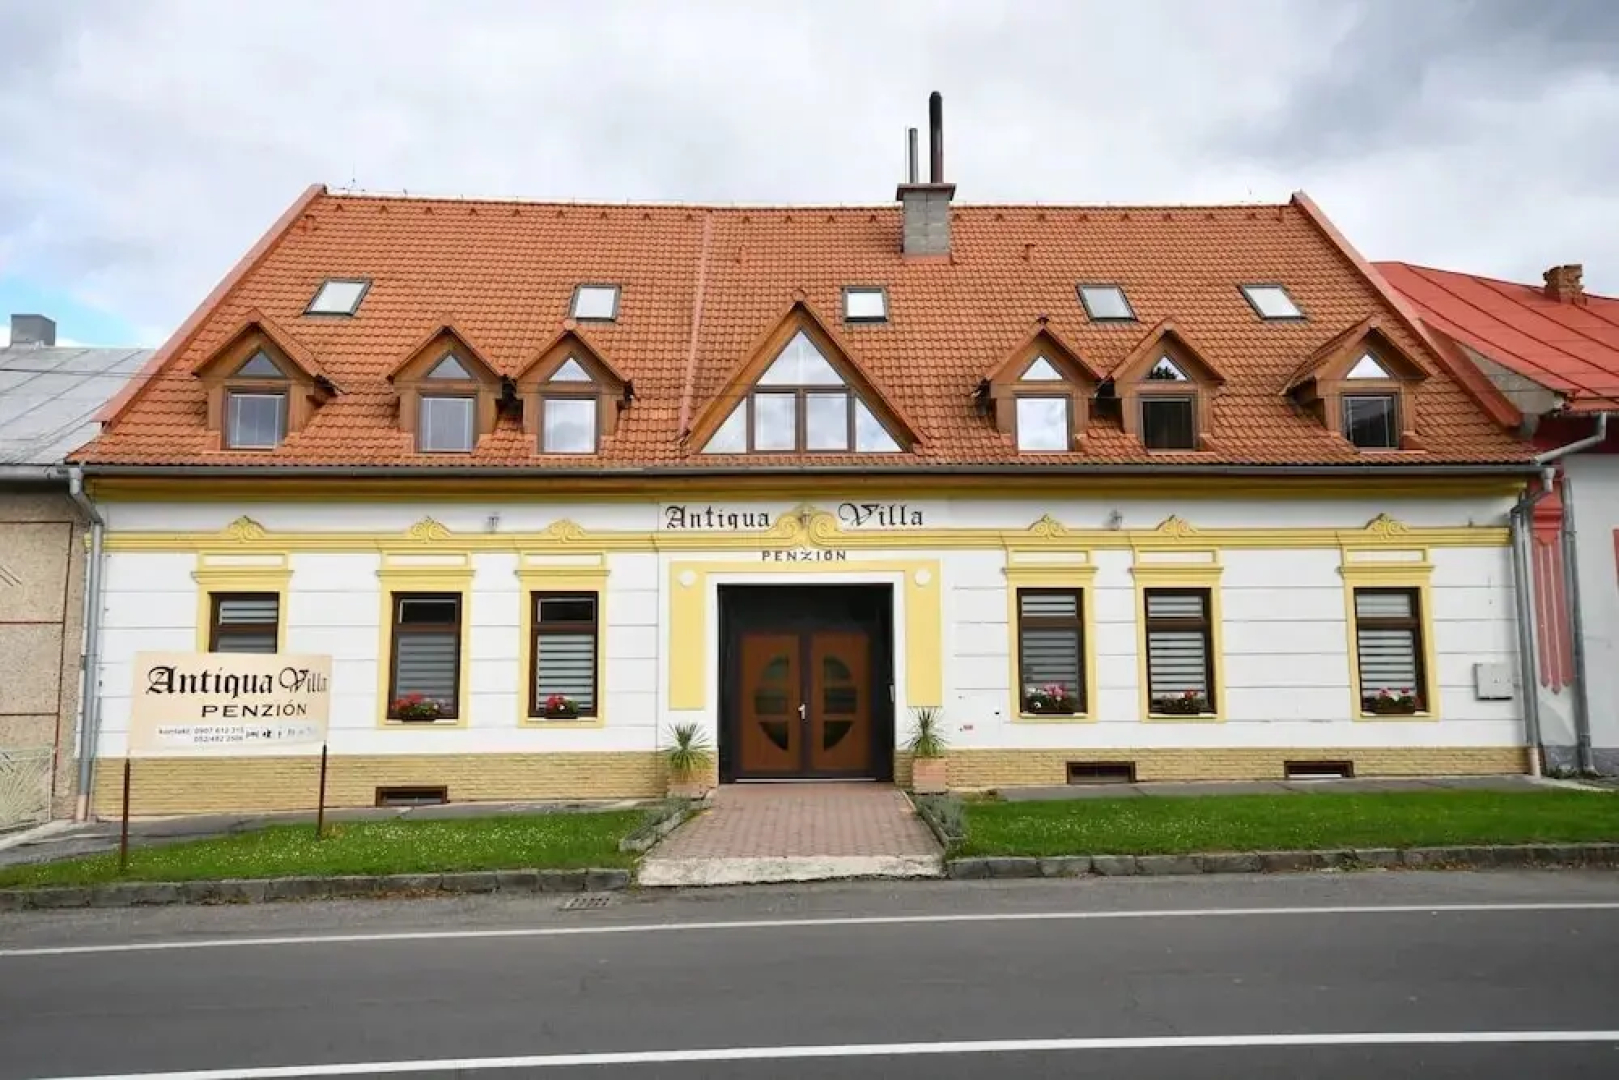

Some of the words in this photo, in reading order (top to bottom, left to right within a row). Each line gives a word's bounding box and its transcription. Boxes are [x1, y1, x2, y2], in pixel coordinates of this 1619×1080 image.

[665, 505, 770, 529] Antiqua
[838, 503, 923, 527] Villa
[146, 665, 273, 699] Antiqua
[278, 666, 328, 694] Villa
[201, 699, 307, 718] PENZIÓN
